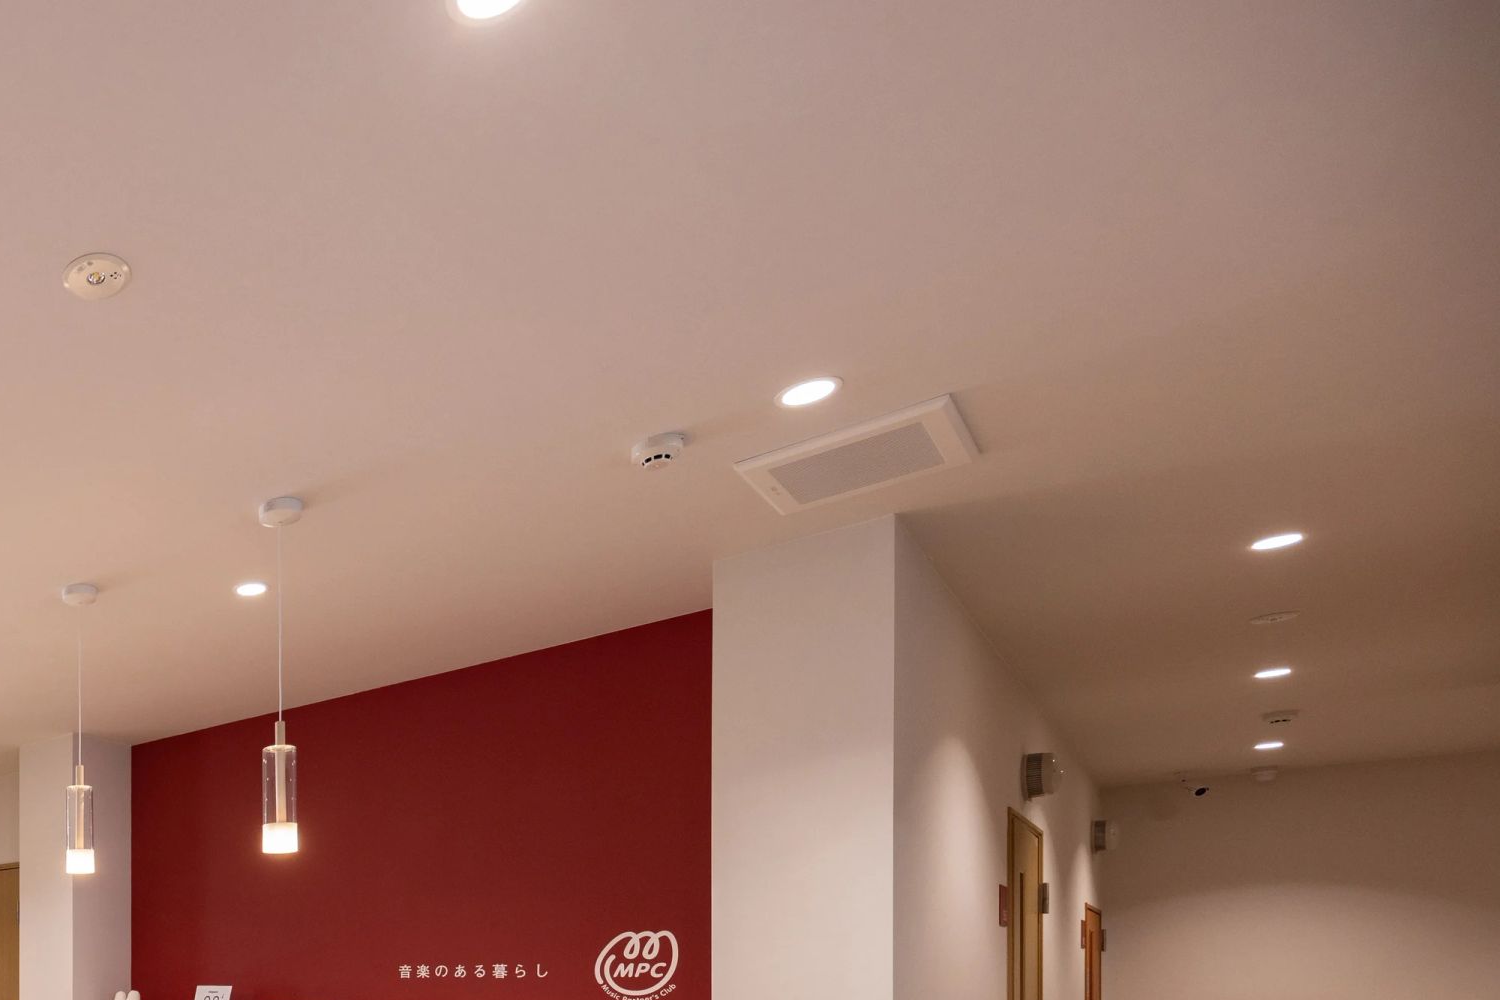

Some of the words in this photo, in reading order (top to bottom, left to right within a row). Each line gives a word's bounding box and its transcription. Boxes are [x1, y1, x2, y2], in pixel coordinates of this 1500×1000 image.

[398, 963, 549, 979] 音楽のある暮らし
[613, 962, 667, 978] MPC
[601, 984, 621, 1000] Music
[659, 983, 677, 997] Club
